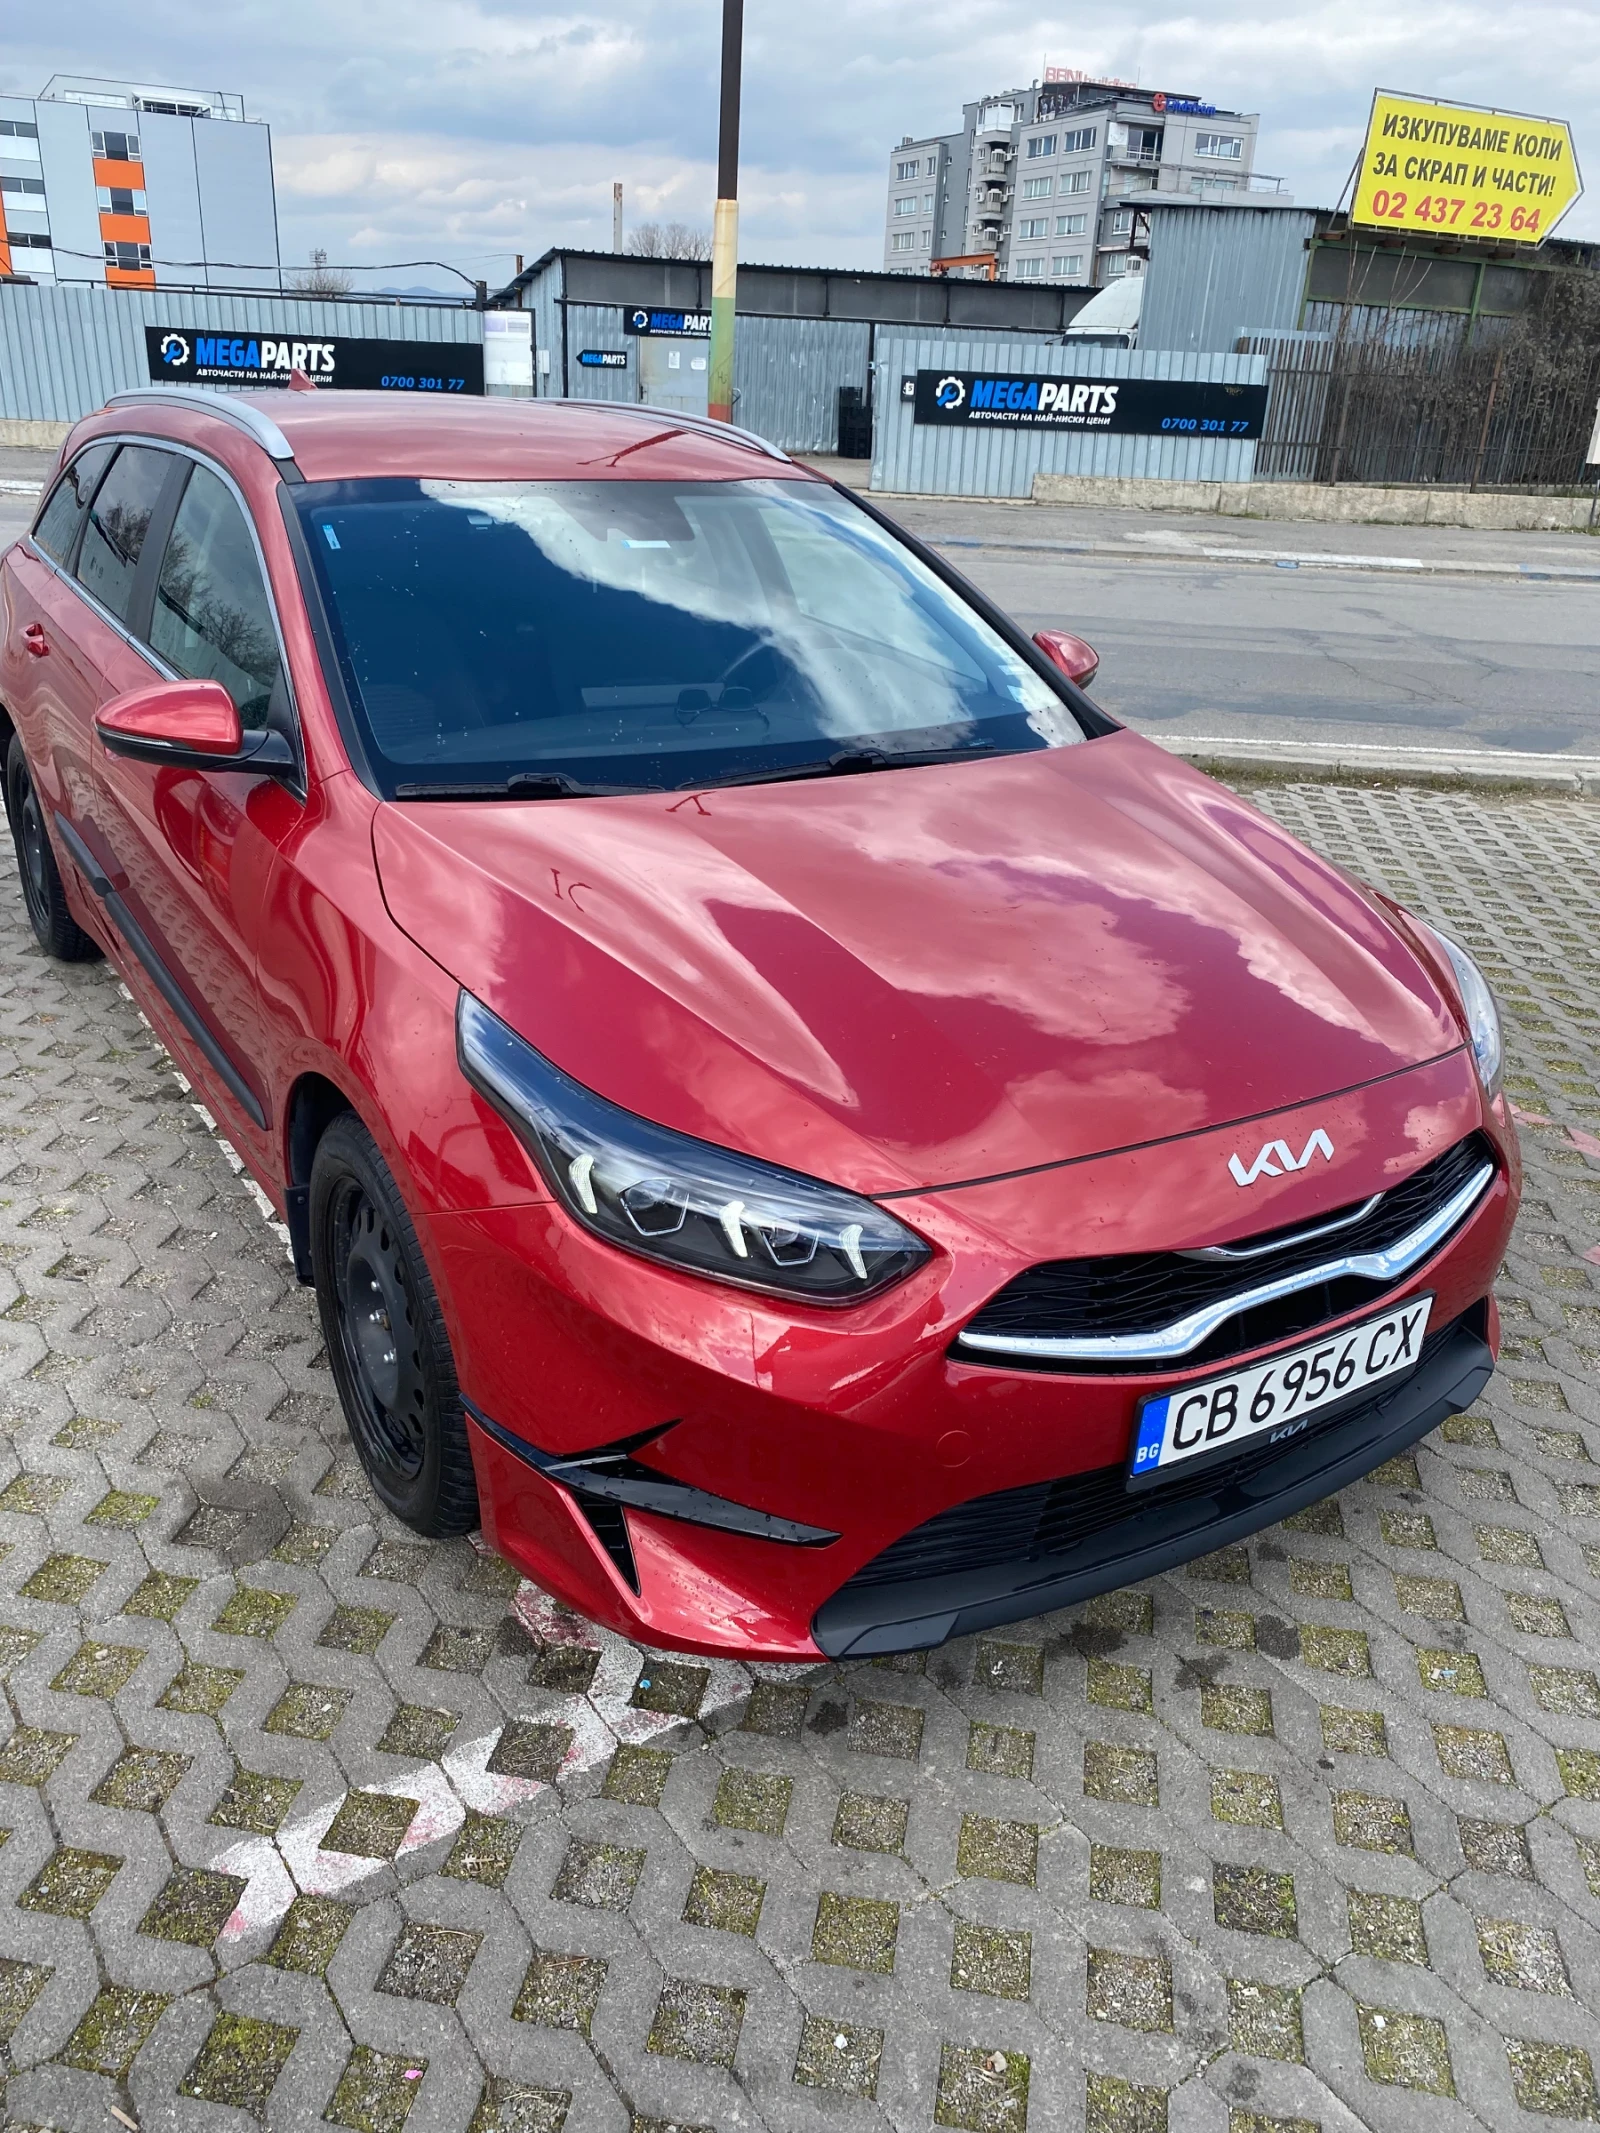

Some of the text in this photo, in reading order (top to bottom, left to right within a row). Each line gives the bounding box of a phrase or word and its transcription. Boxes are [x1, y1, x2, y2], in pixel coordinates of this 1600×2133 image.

[1046, 67, 1083, 82] BENI
[1382, 113, 1563, 161] ИЗКУПУВАМЕ КОЛИ
[1373, 152, 1556, 197] ЗА СКРАП И ЧАСТИ!
[1372, 189, 1541, 233] 02 437 23 64
[650, 313, 712, 331] MEGAPART
[195, 337, 336, 372] MEGAPARTS
[582, 353, 626, 365] MEGAPARTS
[196, 368, 245, 379] АВТОЧАСТИ
[246, 370, 259, 379] НА
[310, 374, 333, 383] ЦЕНИ
[381, 375, 465, 390] 0700 301 77
[970, 379, 1119, 414] MEGAPARTS
[969, 411, 1110, 426] АВТОЧАСТИ НА НАЙ-НИСКИ ЦЕНИ
[1161, 418, 1249, 433] 0700 301 77
[1172, 1308, 1422, 1450] CB 6956 CX
[1136, 1443, 1160, 1463] BG
